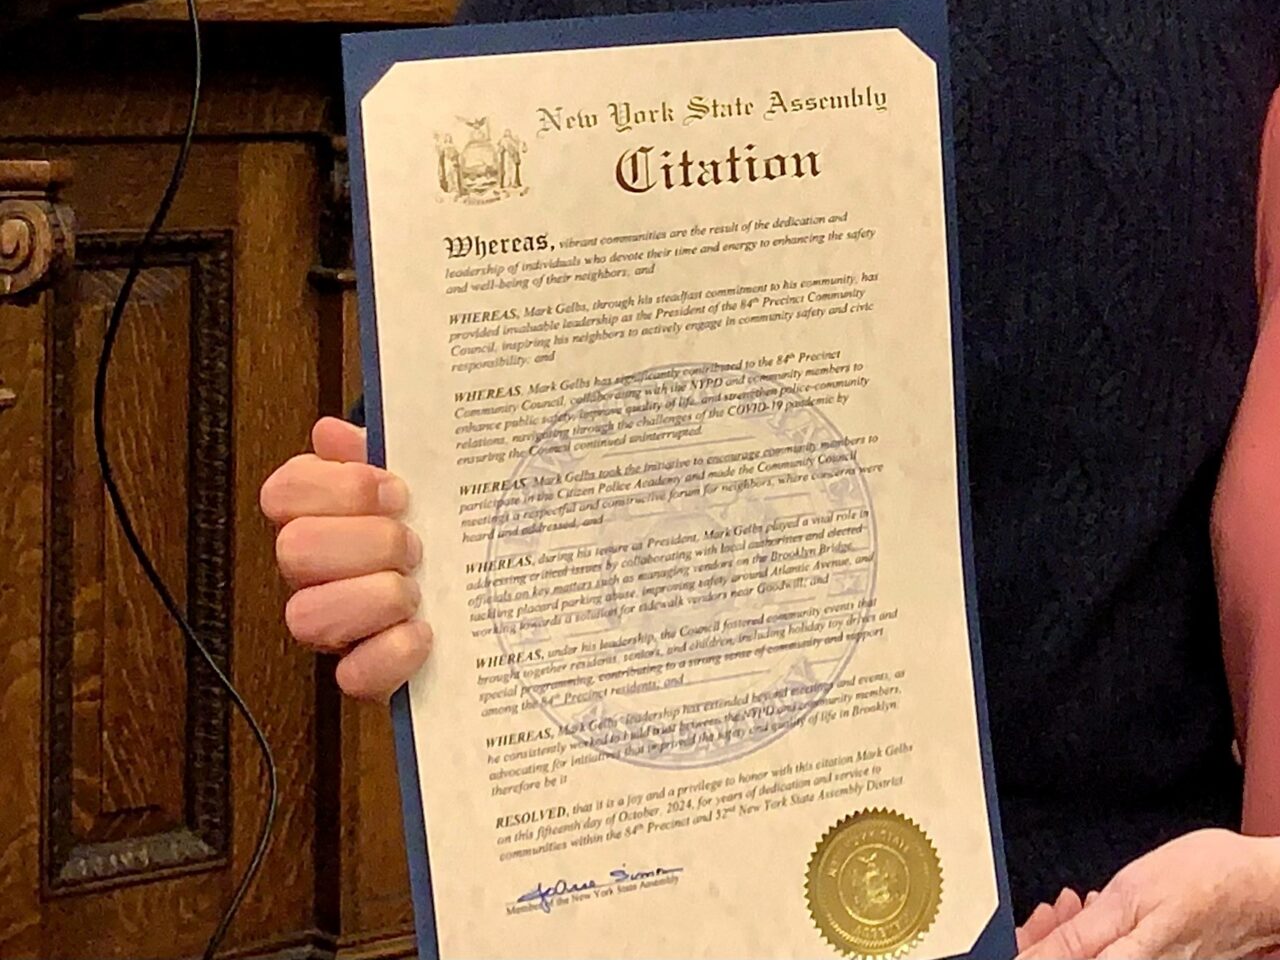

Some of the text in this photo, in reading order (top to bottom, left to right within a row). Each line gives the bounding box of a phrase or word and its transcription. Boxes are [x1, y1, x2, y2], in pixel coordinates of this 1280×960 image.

[536, 85, 888, 138] New York State Assembly
[615, 143, 822, 193] Citation
[444, 232, 555, 259] Whereas,
